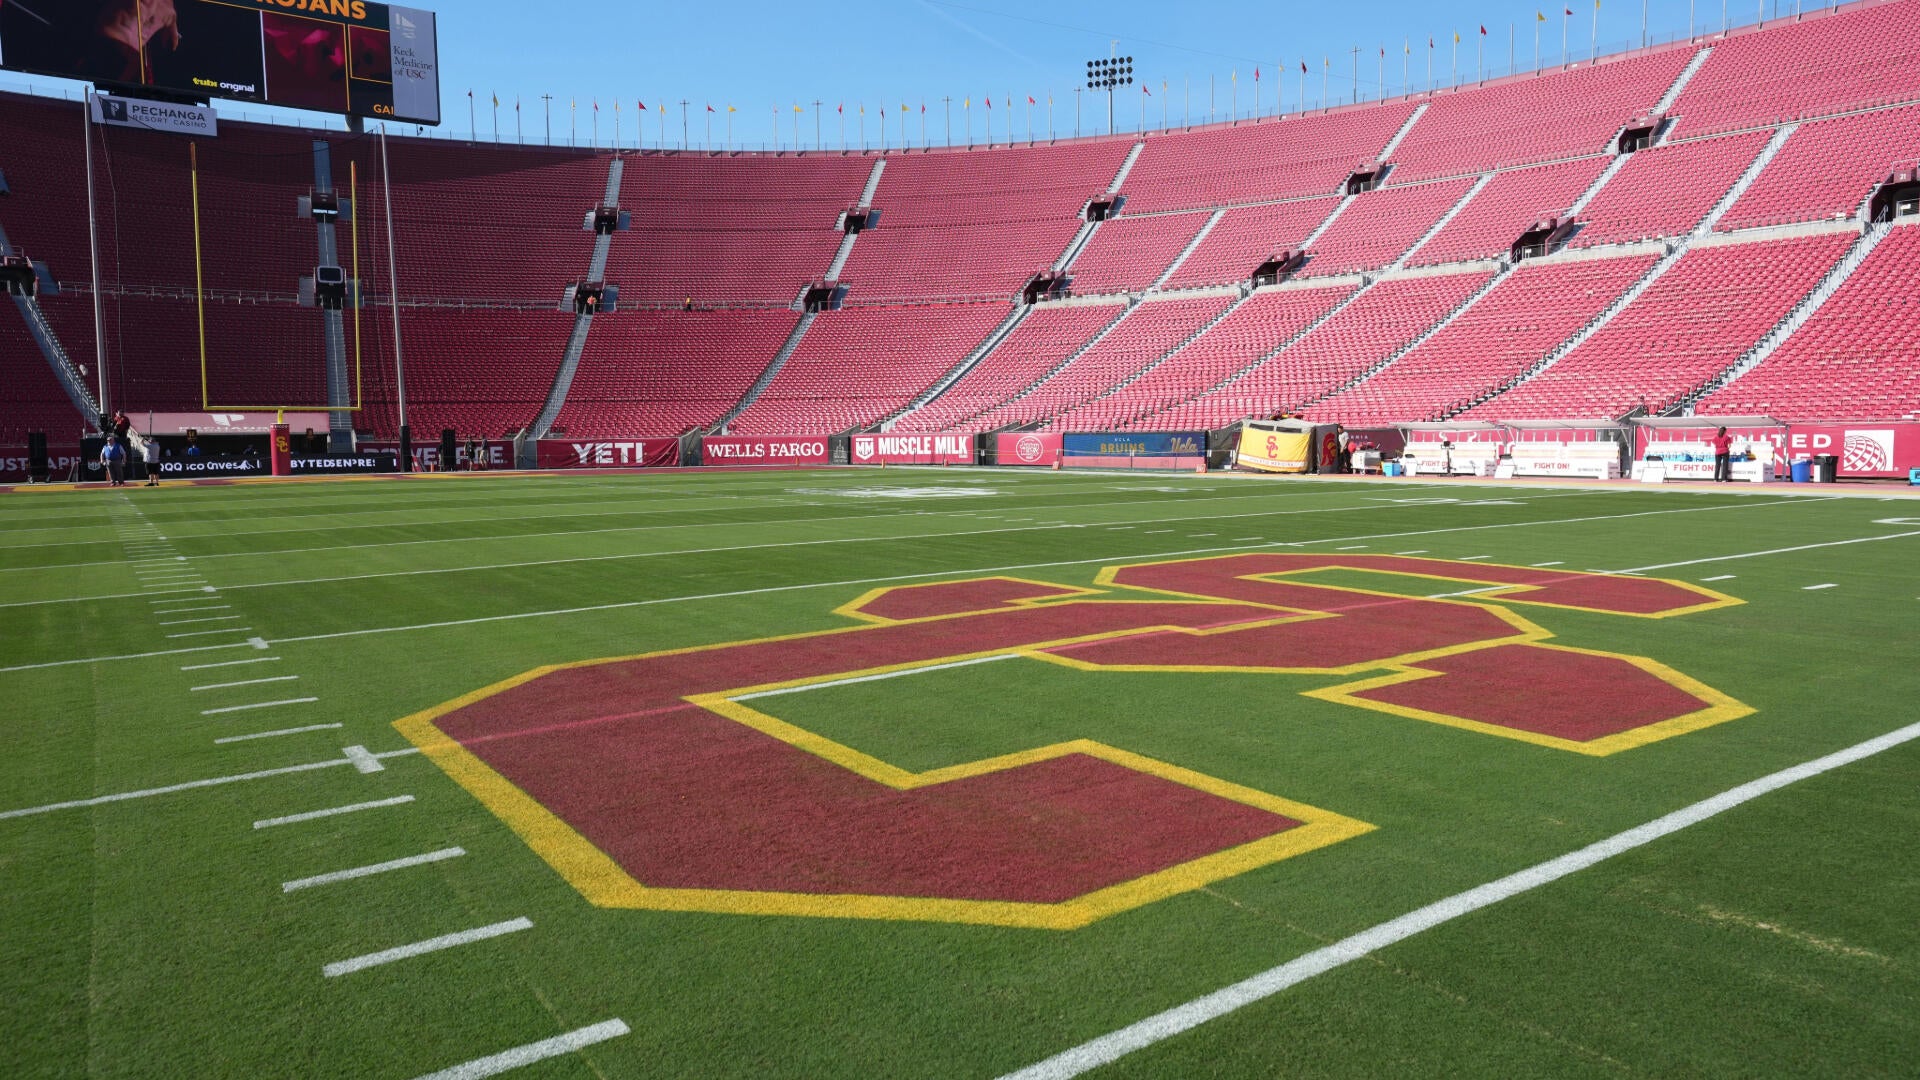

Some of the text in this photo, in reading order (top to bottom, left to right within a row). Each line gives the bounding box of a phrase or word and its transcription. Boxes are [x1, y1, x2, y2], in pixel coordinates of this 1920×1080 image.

[392, 45, 415, 57] Keck
[393, 56, 433, 70] Medicine
[394, 67, 426, 80] of USC
[219, 81, 255, 93] original
[132, 104, 205, 122] PECHANGA
[373, 103, 394, 114] GA
[132, 114, 206, 129] RESORT CASINO
[707, 442, 824, 457] WELLS FARGO
[878, 437, 931, 455] MUSCLE
[935, 436, 968, 455] MILK
[1100, 443, 1145, 454] BRUINS
[1266, 435, 1279, 459] SC
[572, 442, 644, 464] YETI
[1533, 462, 1555, 470] FIGHT
